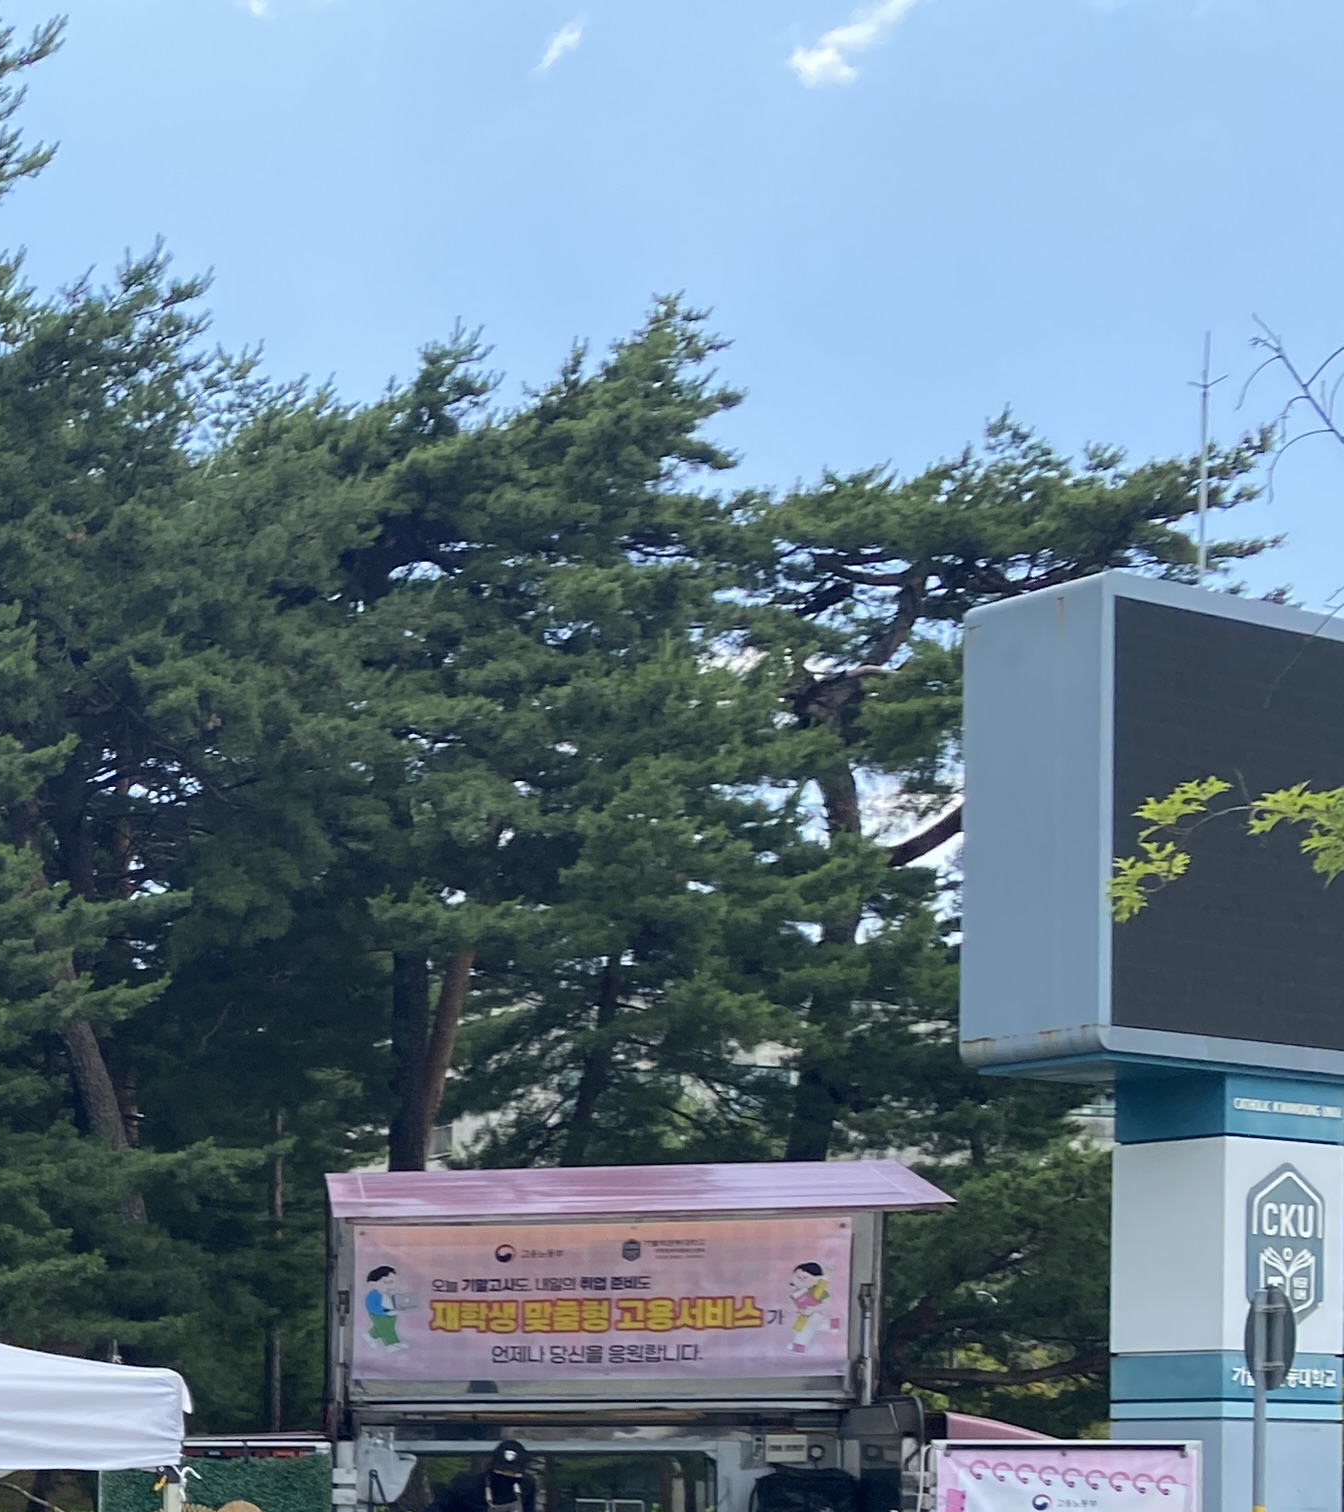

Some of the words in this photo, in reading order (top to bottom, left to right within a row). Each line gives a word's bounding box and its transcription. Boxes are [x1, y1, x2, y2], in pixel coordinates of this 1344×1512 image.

[1262, 1202, 1315, 1238] CKU
[431, 1279, 458, 1292] 오늘
[430, 1300, 517, 1332] 재학생
[522, 1299, 611, 1332] 맞춤형
[491, 1345, 545, 1364] 언제나
[550, 1345, 604, 1364] 당신을
[1232, 1366, 1337, 1389] 가톨동대학교
